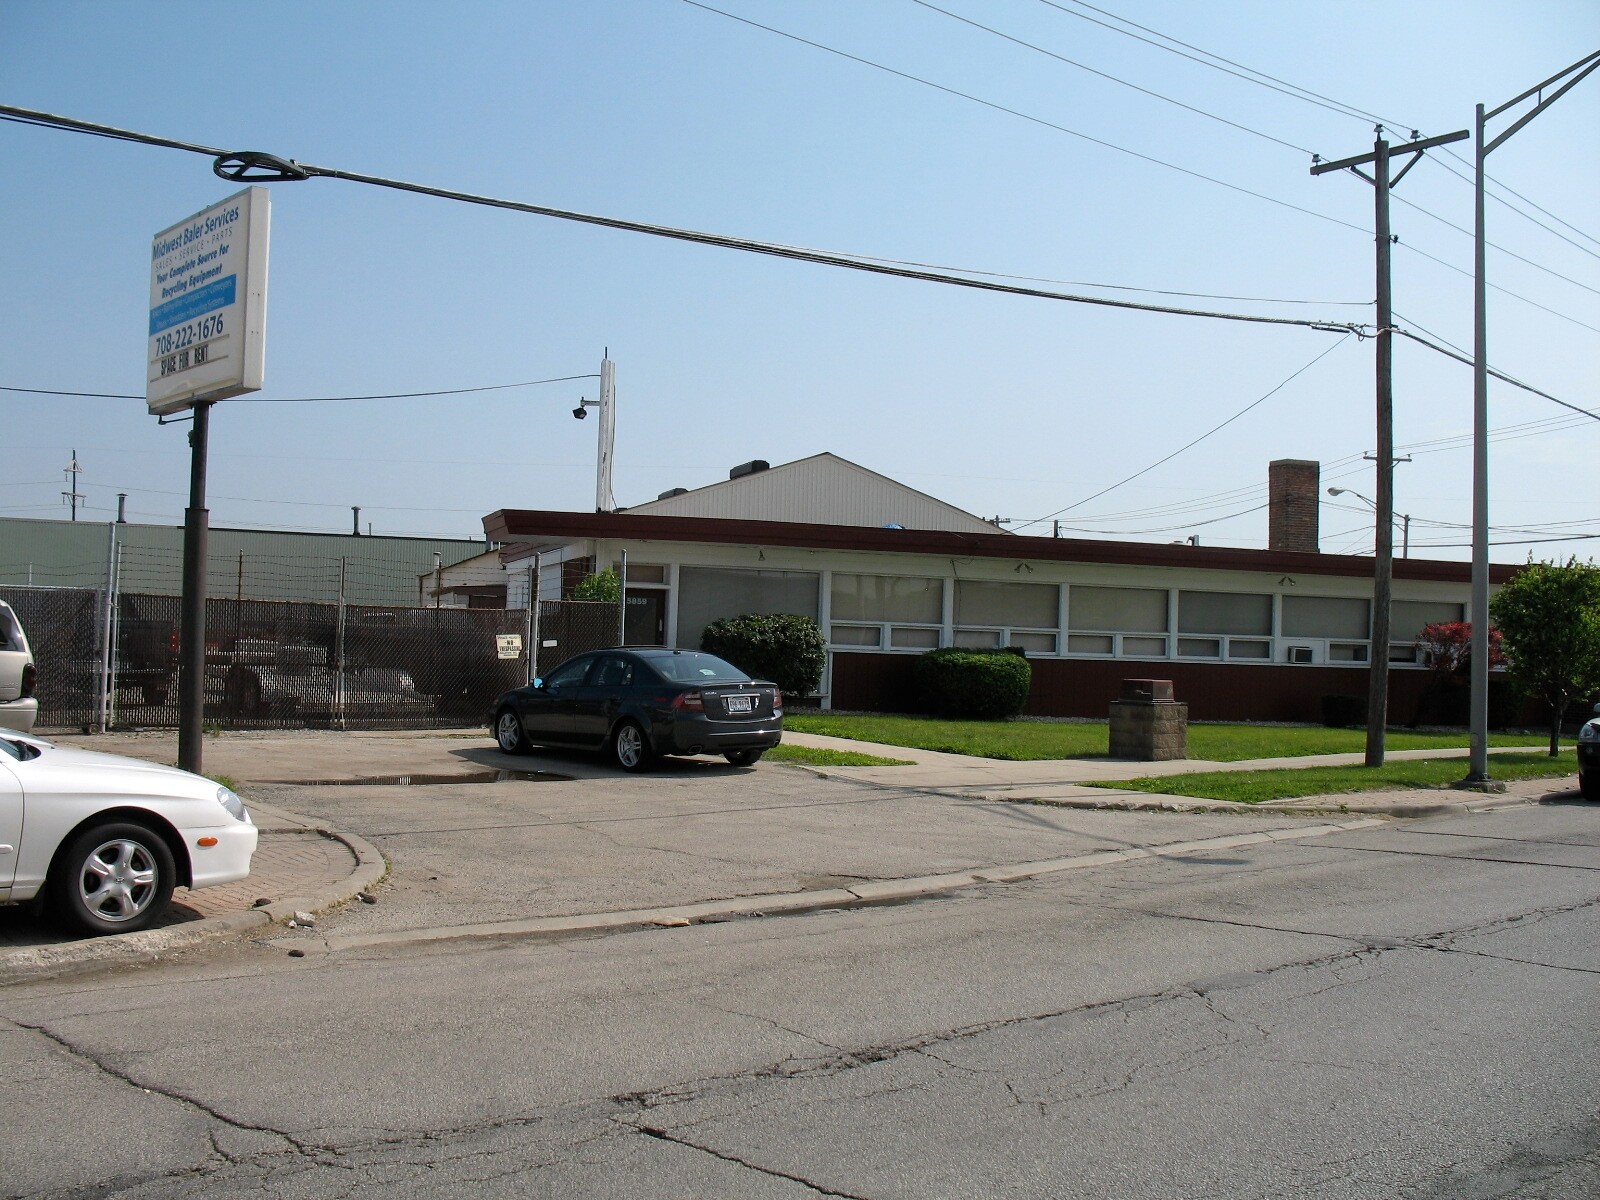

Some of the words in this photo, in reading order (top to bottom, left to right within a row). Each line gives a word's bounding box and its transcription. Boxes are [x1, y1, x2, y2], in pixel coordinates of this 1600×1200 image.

[152, 233, 182, 260] Midwest
[184, 223, 204, 245] Baler
[205, 206, 239, 234] Services
[155, 256, 173, 273] SALES
[179, 239, 204, 260] SERVICE
[211, 226, 233, 244] PARTS
[156, 272, 168, 285] Your
[169, 258, 196, 279] Complete
[197, 249, 218, 266] Source
[219, 243, 230, 256] for
[161, 280, 188, 299] Recycling
[189, 263, 223, 287] Equipment
[155, 313, 224, 357] 708-222-1676
[160, 355, 177, 376] SPACE
[179, 351, 190, 370] FOR
[194, 345, 209, 365] RENT
